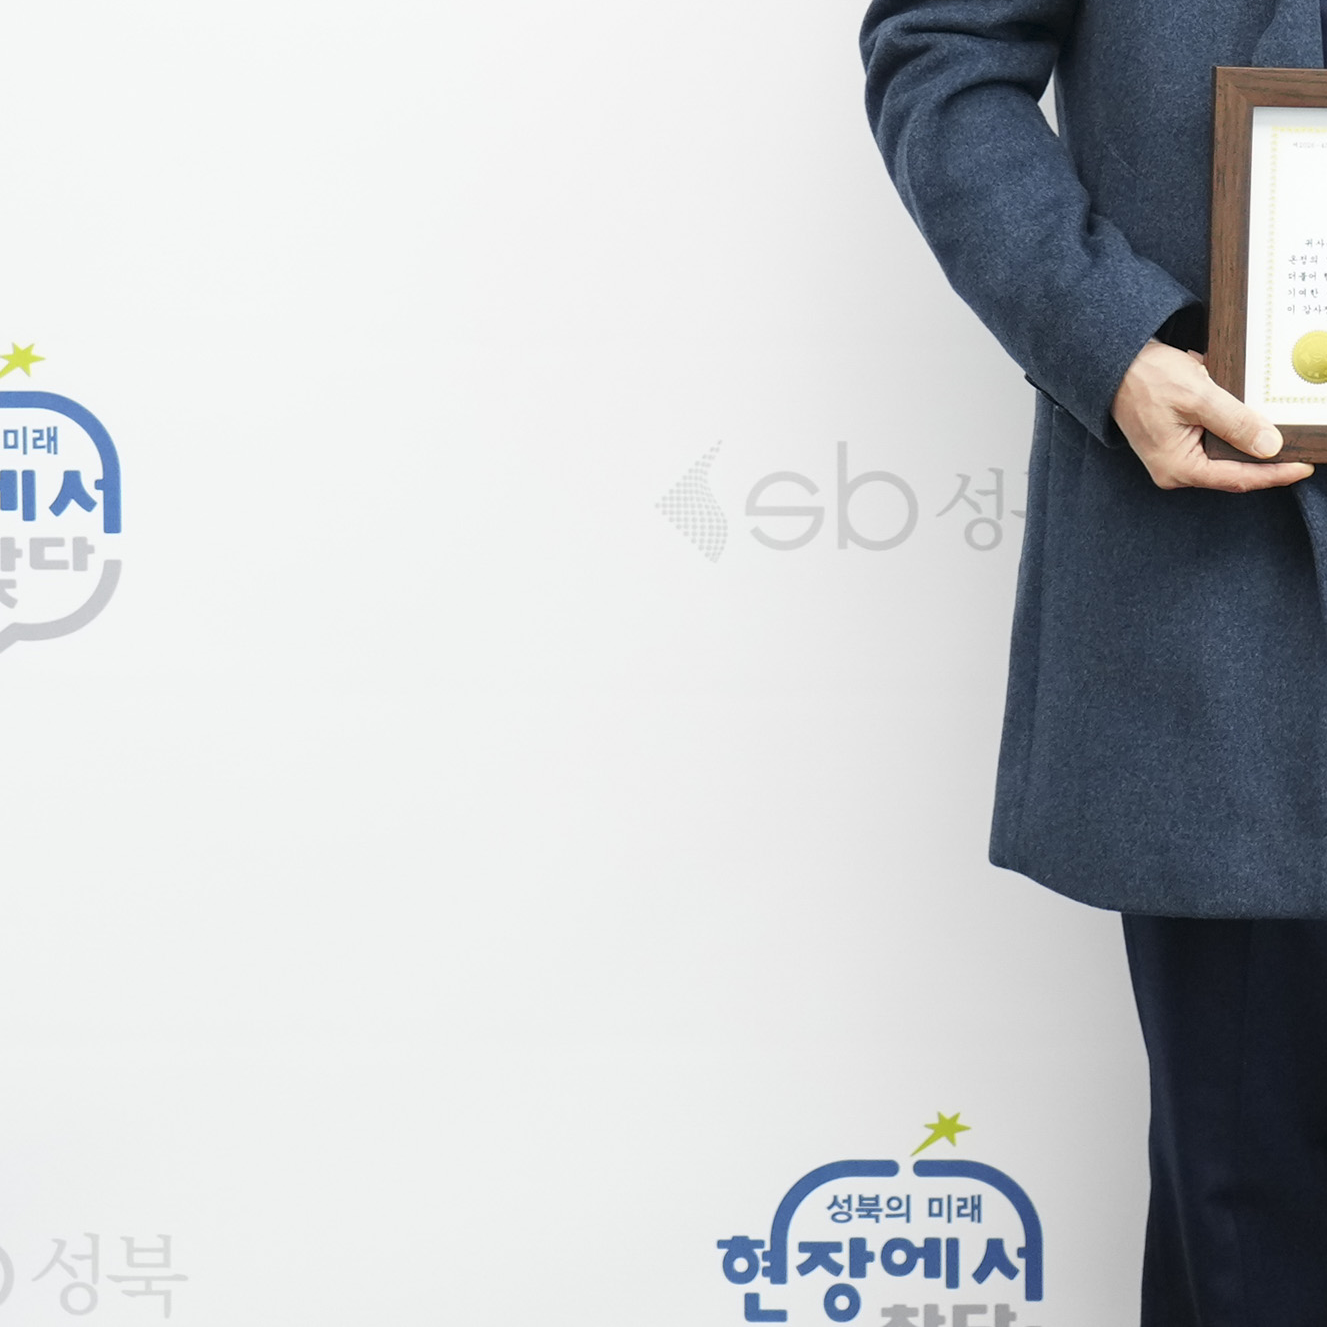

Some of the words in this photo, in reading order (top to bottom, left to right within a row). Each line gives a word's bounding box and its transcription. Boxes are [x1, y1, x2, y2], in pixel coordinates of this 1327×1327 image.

[3, 426, 59, 456] 미래
[744, 441, 919, 551] sb
[936, 467, 1027, 552] 성
[827, 1194, 911, 1224] 성북의
[928, 1194, 983, 1224] 미래
[31, 1231, 189, 1319] 성북
[717, 1235, 1044, 1323] 현장에서
